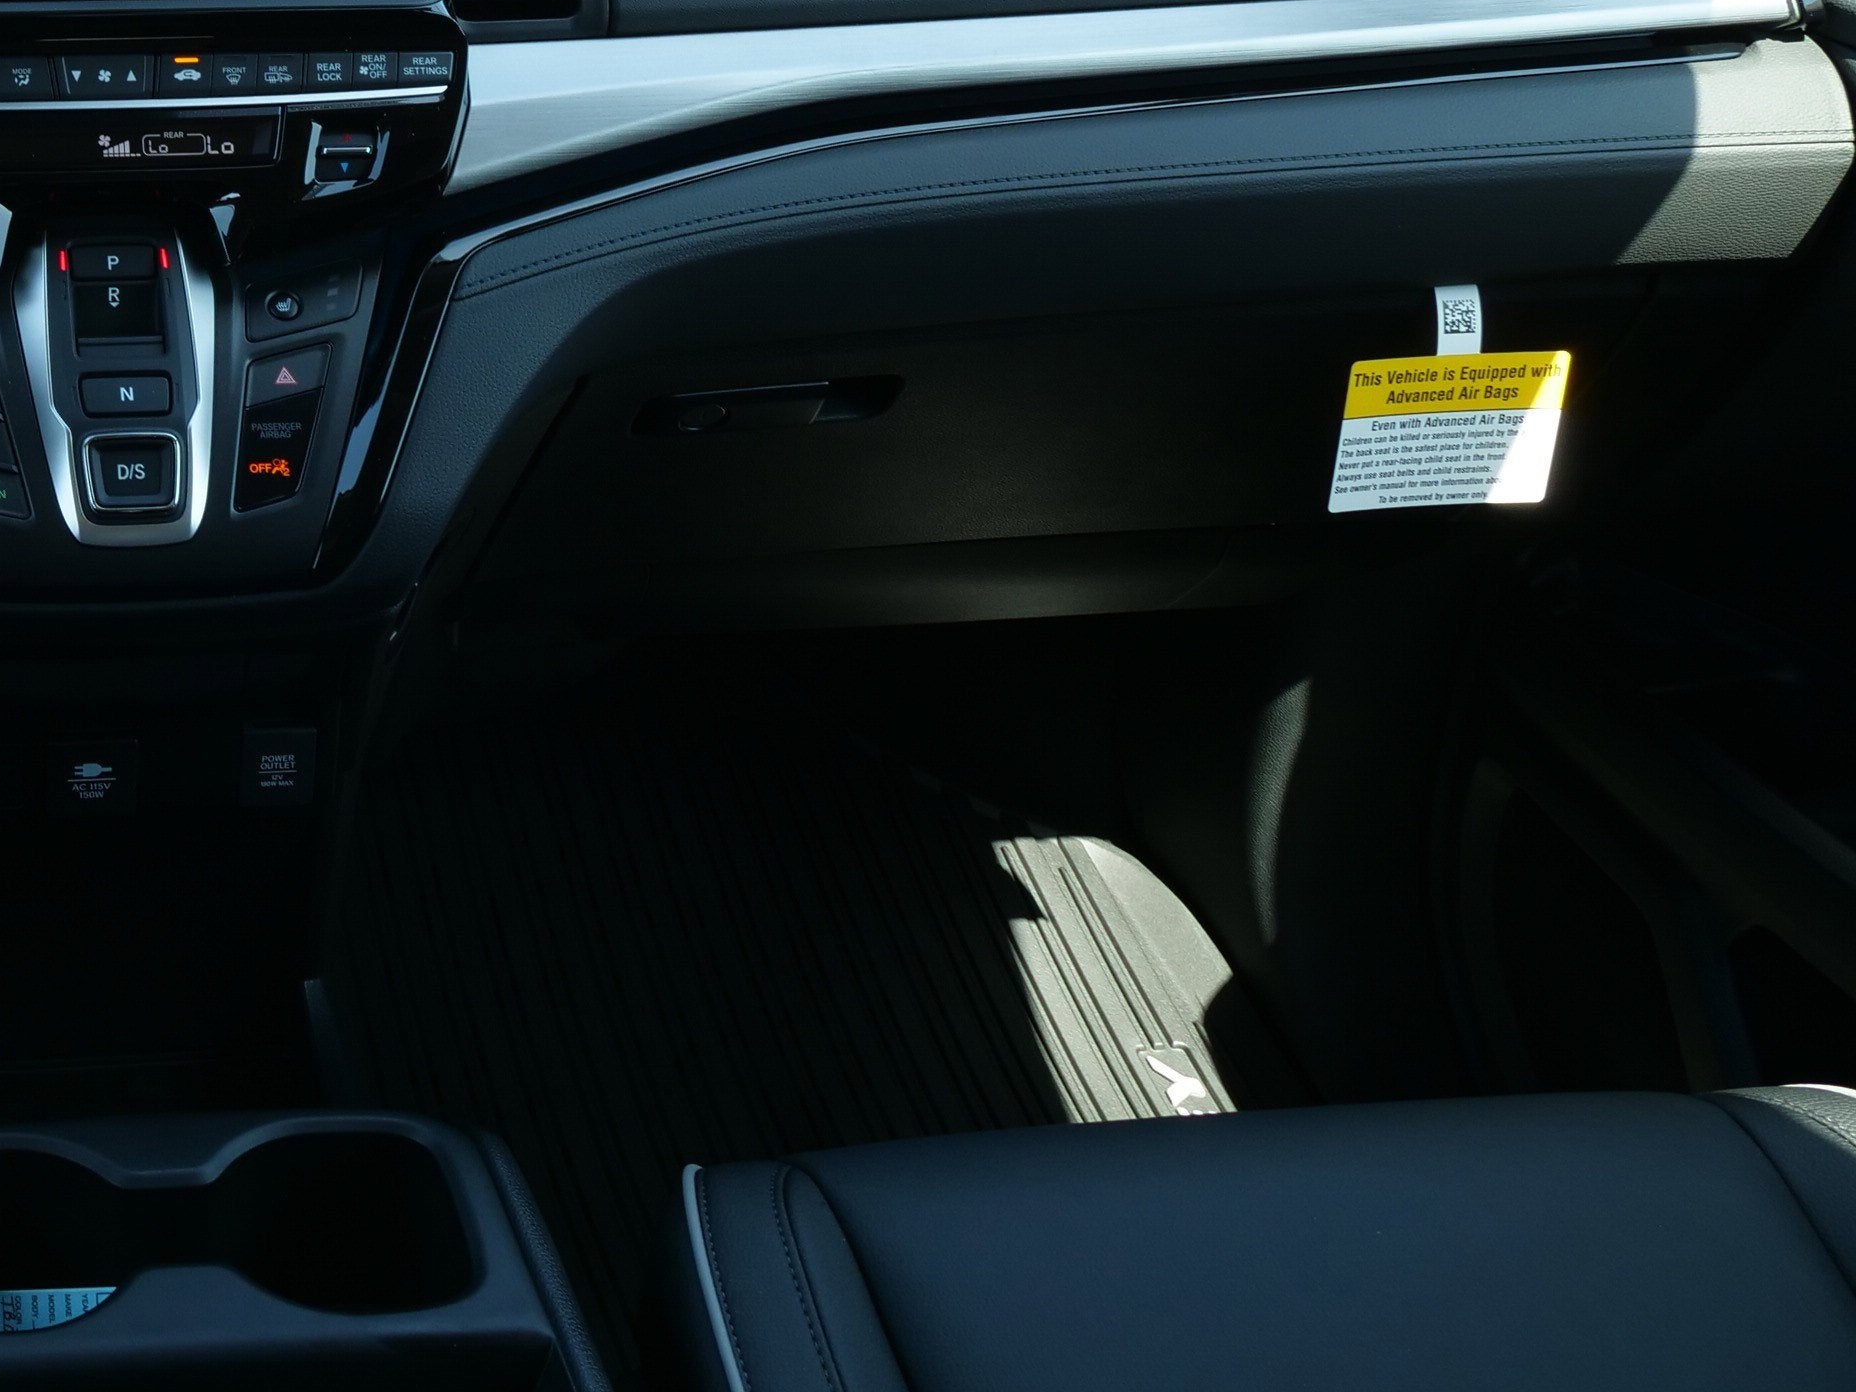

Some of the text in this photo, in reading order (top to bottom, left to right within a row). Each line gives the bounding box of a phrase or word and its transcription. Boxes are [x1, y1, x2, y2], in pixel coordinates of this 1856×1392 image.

[361, 54, 387, 63] REAR
[412, 56, 437, 66] REAR
[316, 62, 342, 72] REAR
[403, 66, 448, 76] SETTINGS
[317, 72, 343, 82] LOCK
[369, 70, 388, 79] OFF
[163, 131, 184, 139] REAR
[107, 255, 119, 270] P
[108, 288, 120, 302] R
[1354, 372, 1382, 388] This
[1387, 368, 1439, 385] Vehicle
[1443, 367, 1455, 381] is
[1459, 365, 1526, 384] Equipped
[119, 386, 135, 402] N
[1385, 384, 1520, 405] Advanced Air Bags
[251, 422, 302, 431] PASSENGER
[1371, 413, 1525, 432] Even with Advanced Air Bags
[259, 430, 292, 439] AIRBAG
[1340, 450, 1354, 459] The
[1355, 448, 1373, 458] back
[1374, 447, 1391, 456] seat
[1392, 447, 1400, 455] is
[1401, 445, 1413, 454] the
[1414, 443, 1438, 453] safest
[1439, 443, 1461, 452] place
[1462, 442, 1474, 450] for
[117, 463, 146, 481] D/S
[248, 462, 272, 474] OFF
[261, 754, 295, 763] POWER
[260, 762, 296, 770] OUTLET
[71, 782, 112, 791] AC 115V
[79, 790, 104, 799] 150W
